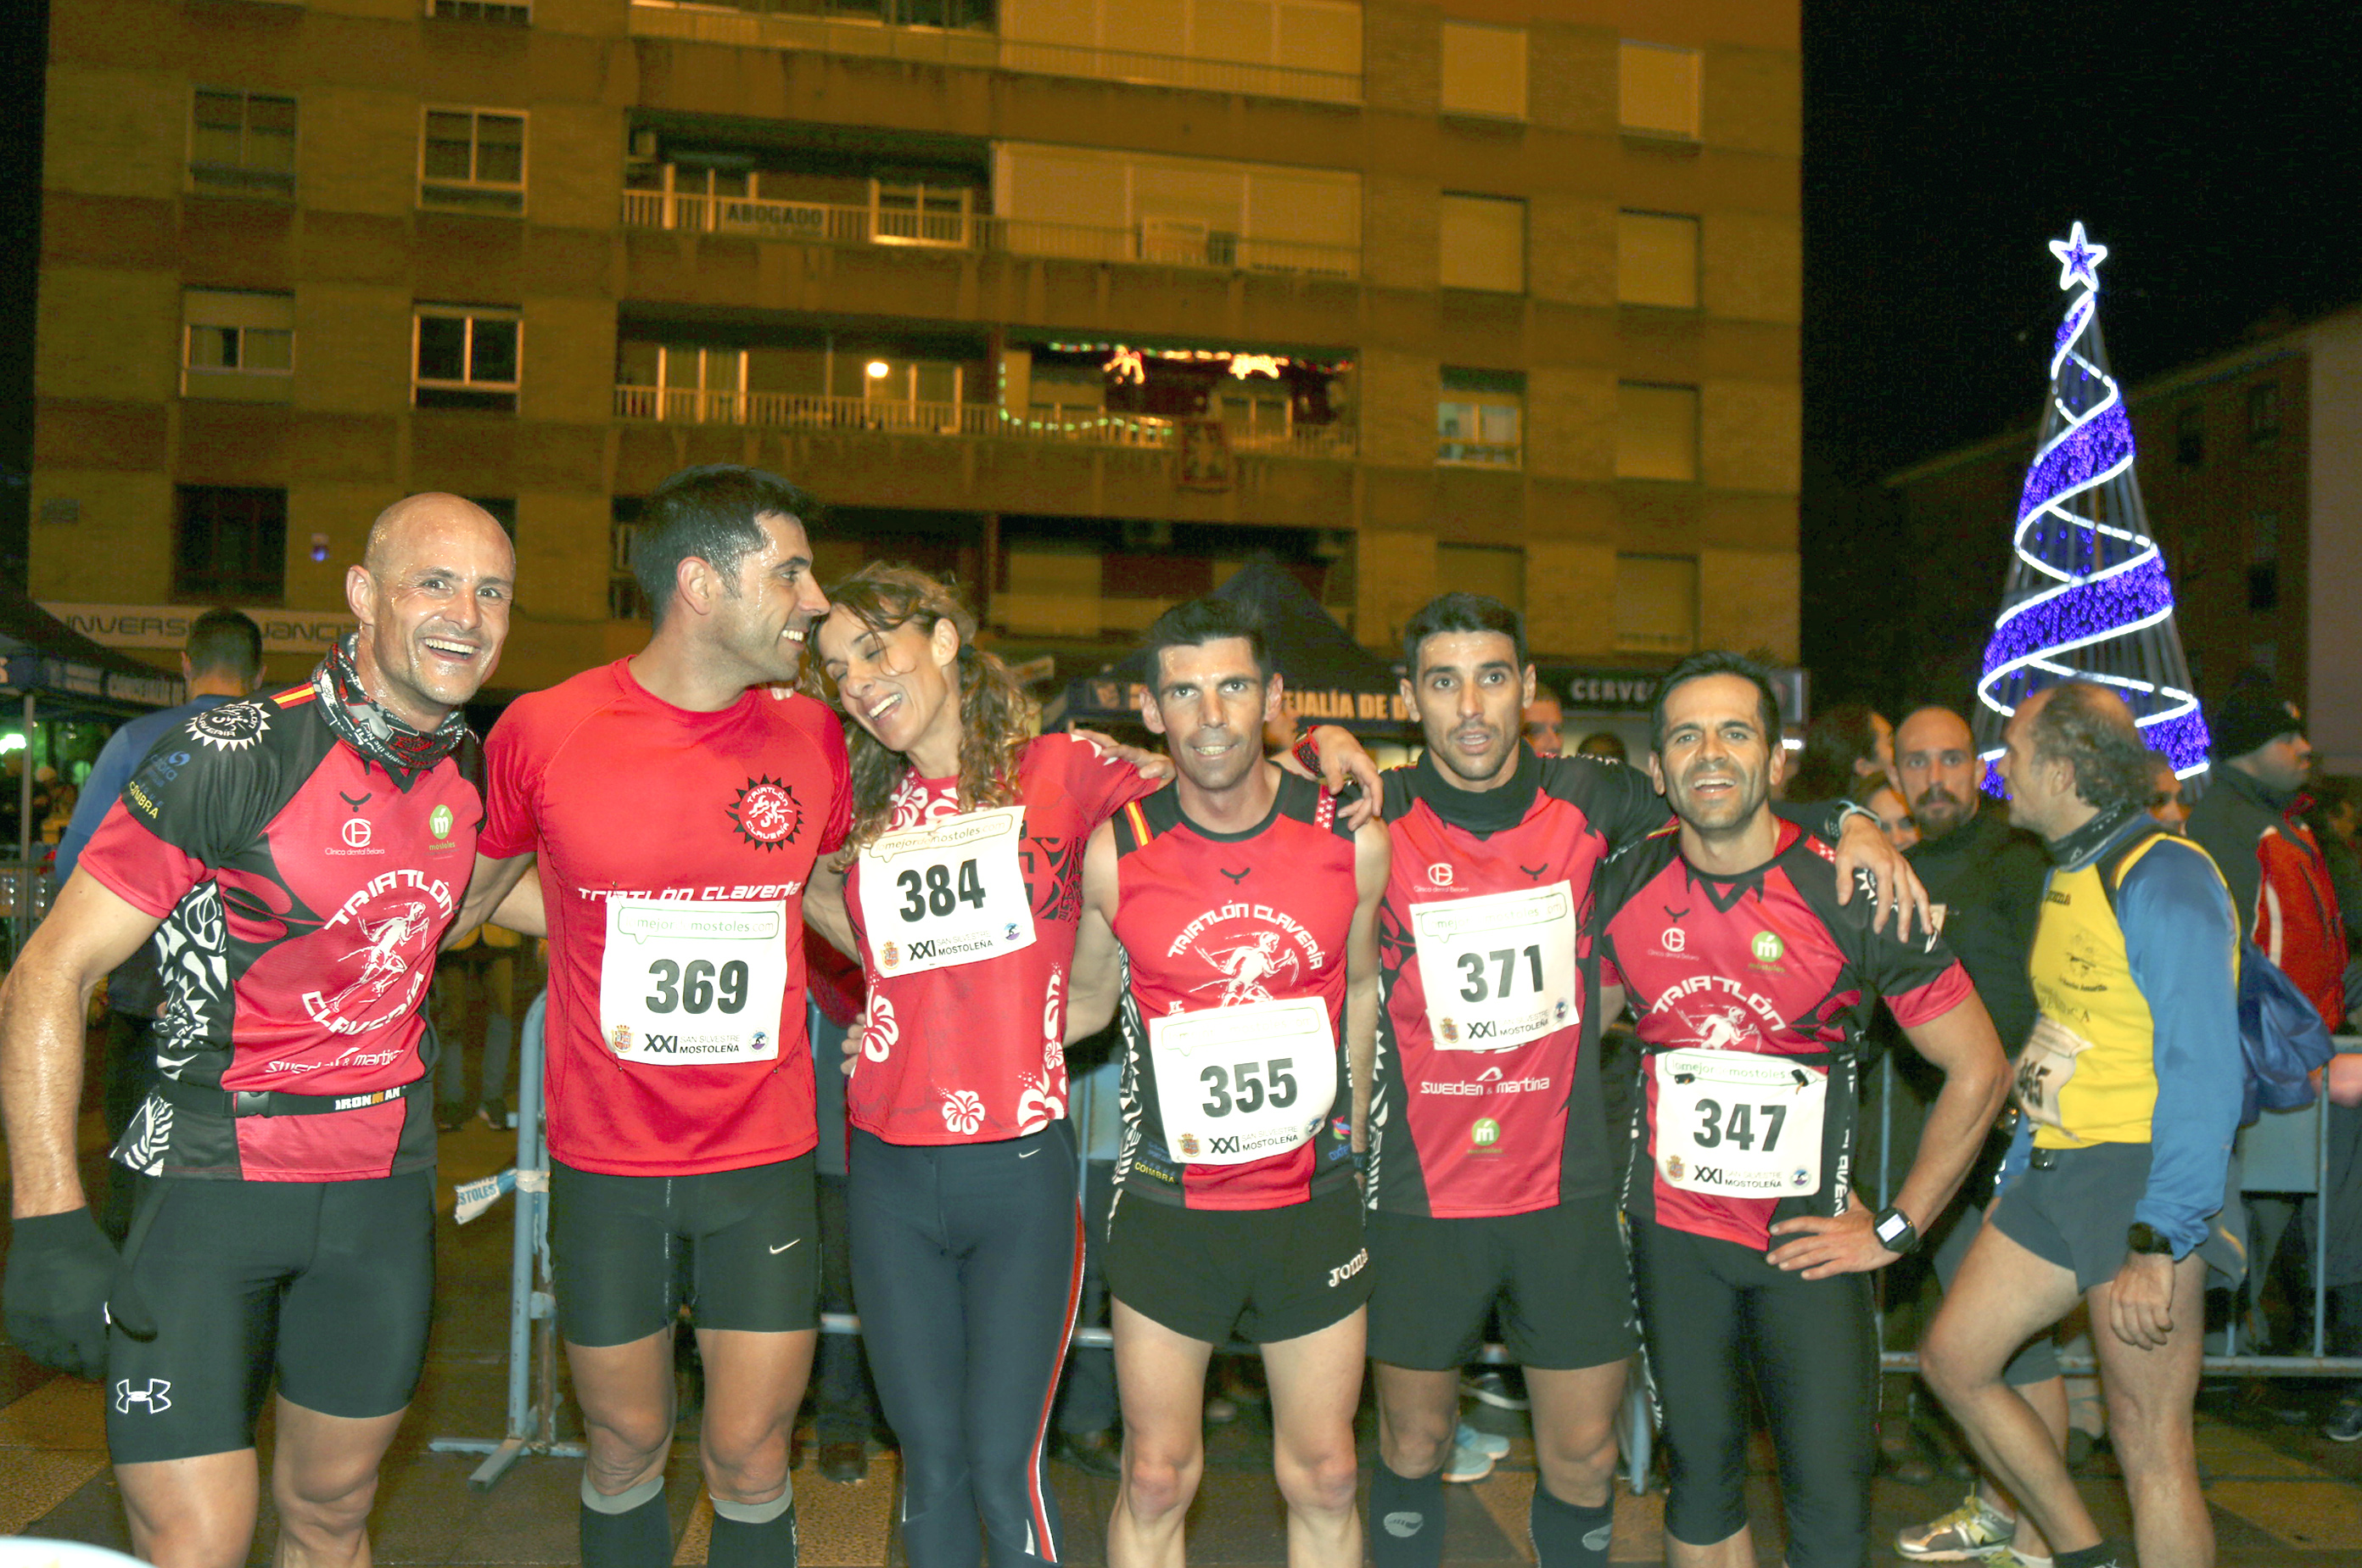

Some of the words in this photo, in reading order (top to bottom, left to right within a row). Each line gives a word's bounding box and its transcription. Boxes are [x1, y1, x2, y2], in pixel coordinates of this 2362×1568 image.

[728, 203, 823, 226] ABOGADO
[1571, 680, 1654, 702] CERVE
[1358, 692, 1389, 721] DE
[747, 786, 789, 807] TRIATLÓN
[746, 820, 790, 840] CLAVERÍA
[323, 869, 453, 931] TRIATLÓN
[896, 858, 987, 923] 384
[1167, 899, 1250, 958] TRIATLÓN
[1253, 904, 1326, 971] CLAVERÍA
[907, 939, 937, 961] XXI
[937, 937, 952, 947] SAN
[938, 938, 993, 957] MOSTOLEÑA
[1457, 944, 1544, 1003] 371
[646, 959, 749, 1015] 369
[1652, 975, 1787, 1033] TRIATLÓN
[1466, 1020, 1497, 1040] XXI
[1499, 1018, 1549, 1037] MOSTOLEÑA
[643, 1033, 678, 1054] XXI
[680, 1034, 698, 1044] SAN
[699, 1034, 741, 1044] SILVESTRE
[679, 1043, 740, 1054] MOSTOLEÑA
[1200, 1057, 1298, 1118] 355
[1486, 1086, 1493, 1095] &
[1496, 1076, 1551, 1095] martina
[334, 1086, 401, 1111] IRONMAN
[1693, 1098, 1788, 1152] 347
[1208, 1135, 1240, 1155] XXI
[1241, 1133, 1257, 1143] SAN
[1257, 1125, 1299, 1140] SILVESTRE
[1242, 1134, 1299, 1152] MOSTOLEÑA
[1134, 1161, 1176, 1184] COIMBRA
[1693, 1165, 1723, 1184] XXI
[1724, 1179, 1783, 1189] MOSTOLEÑA
